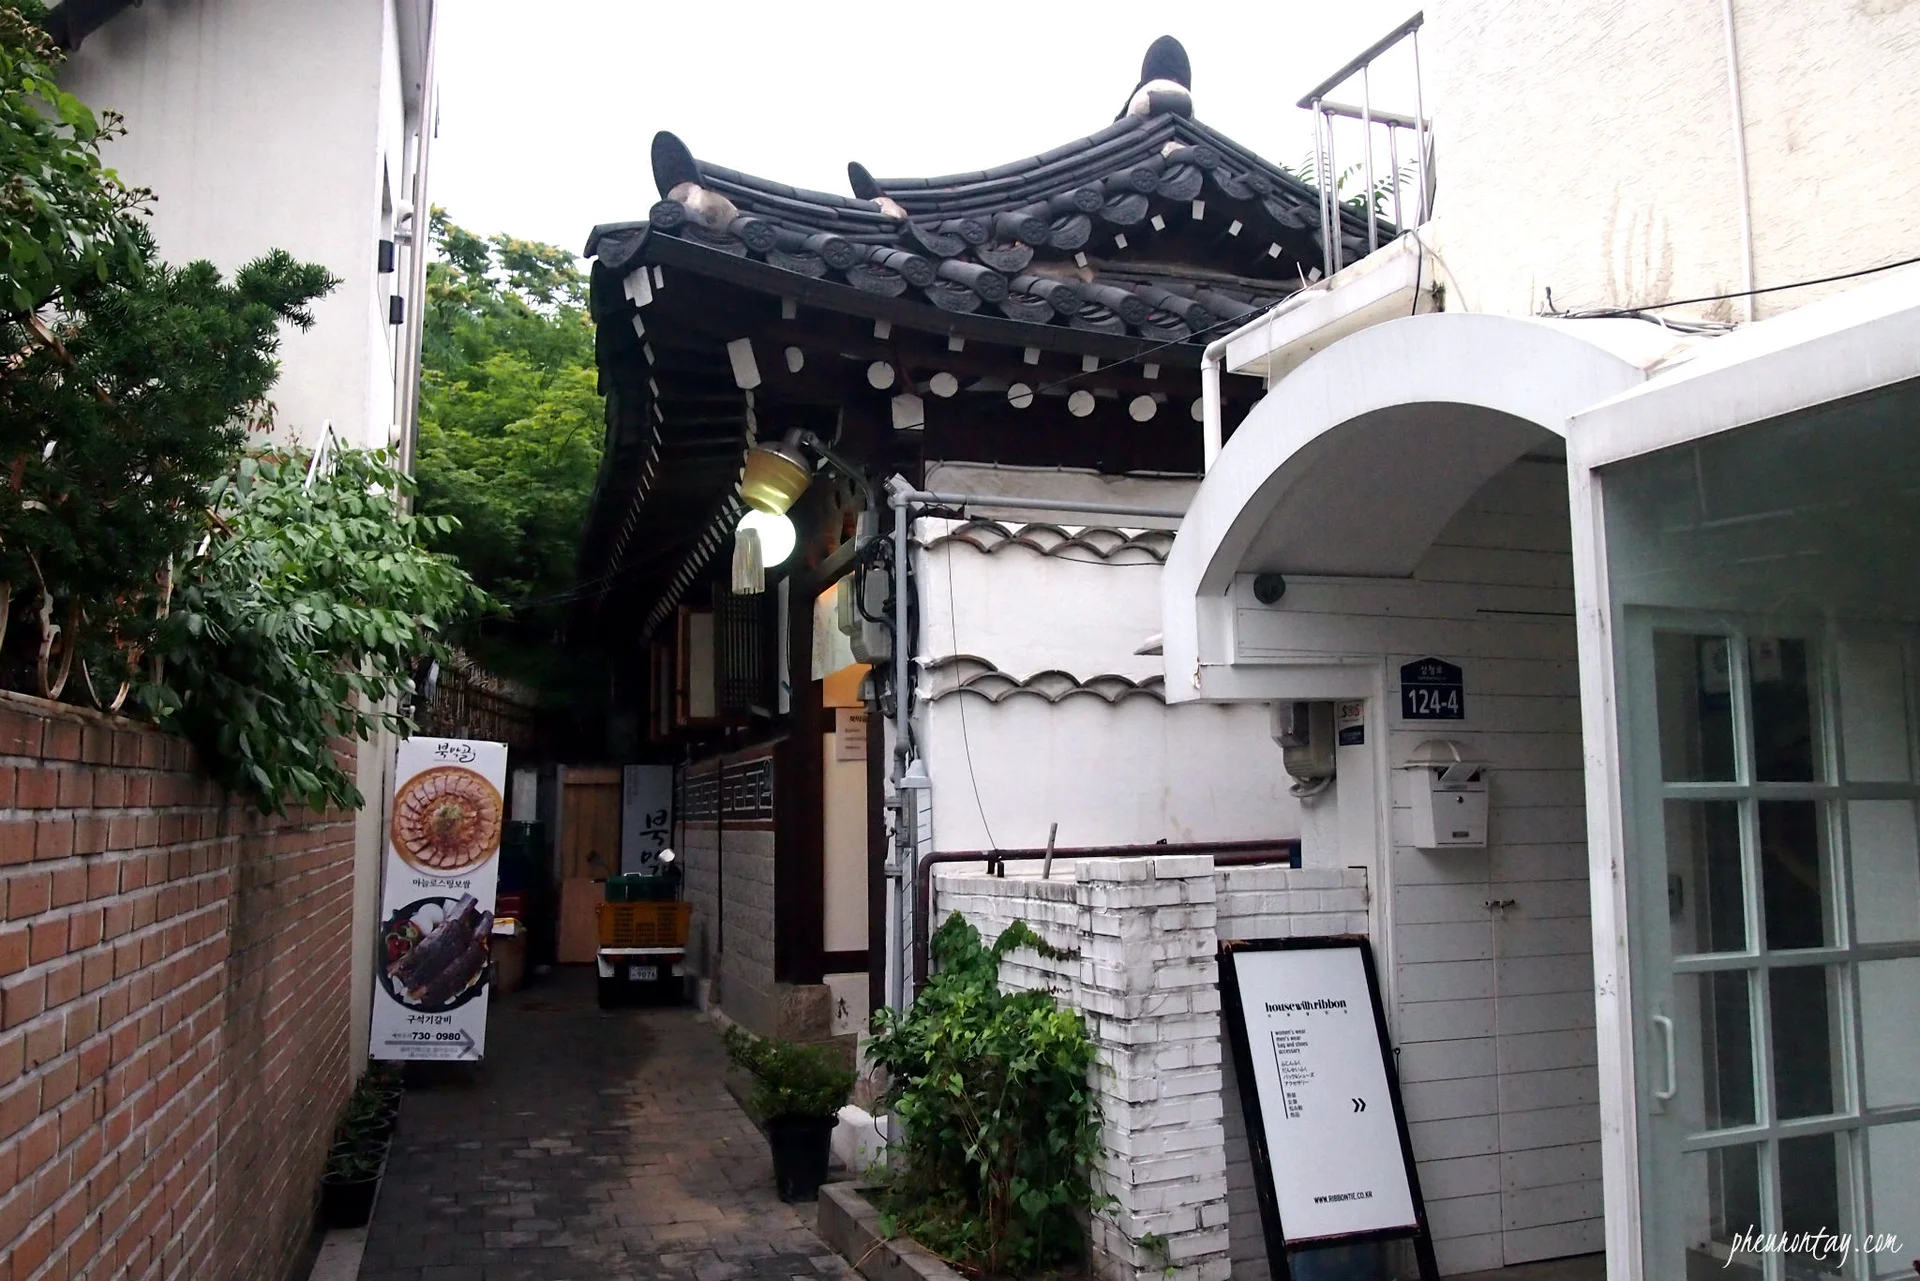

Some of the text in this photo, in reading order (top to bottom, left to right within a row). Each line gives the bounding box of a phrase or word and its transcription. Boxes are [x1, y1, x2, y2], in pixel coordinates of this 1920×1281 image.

[1408, 689, 1459, 714] 124-4
[412, 878, 471, 889] 마늘로스팅보쌈
[1265, 999, 1347, 1012] housewithribbon
[407, 1014, 452, 1024] 구석기갈비
